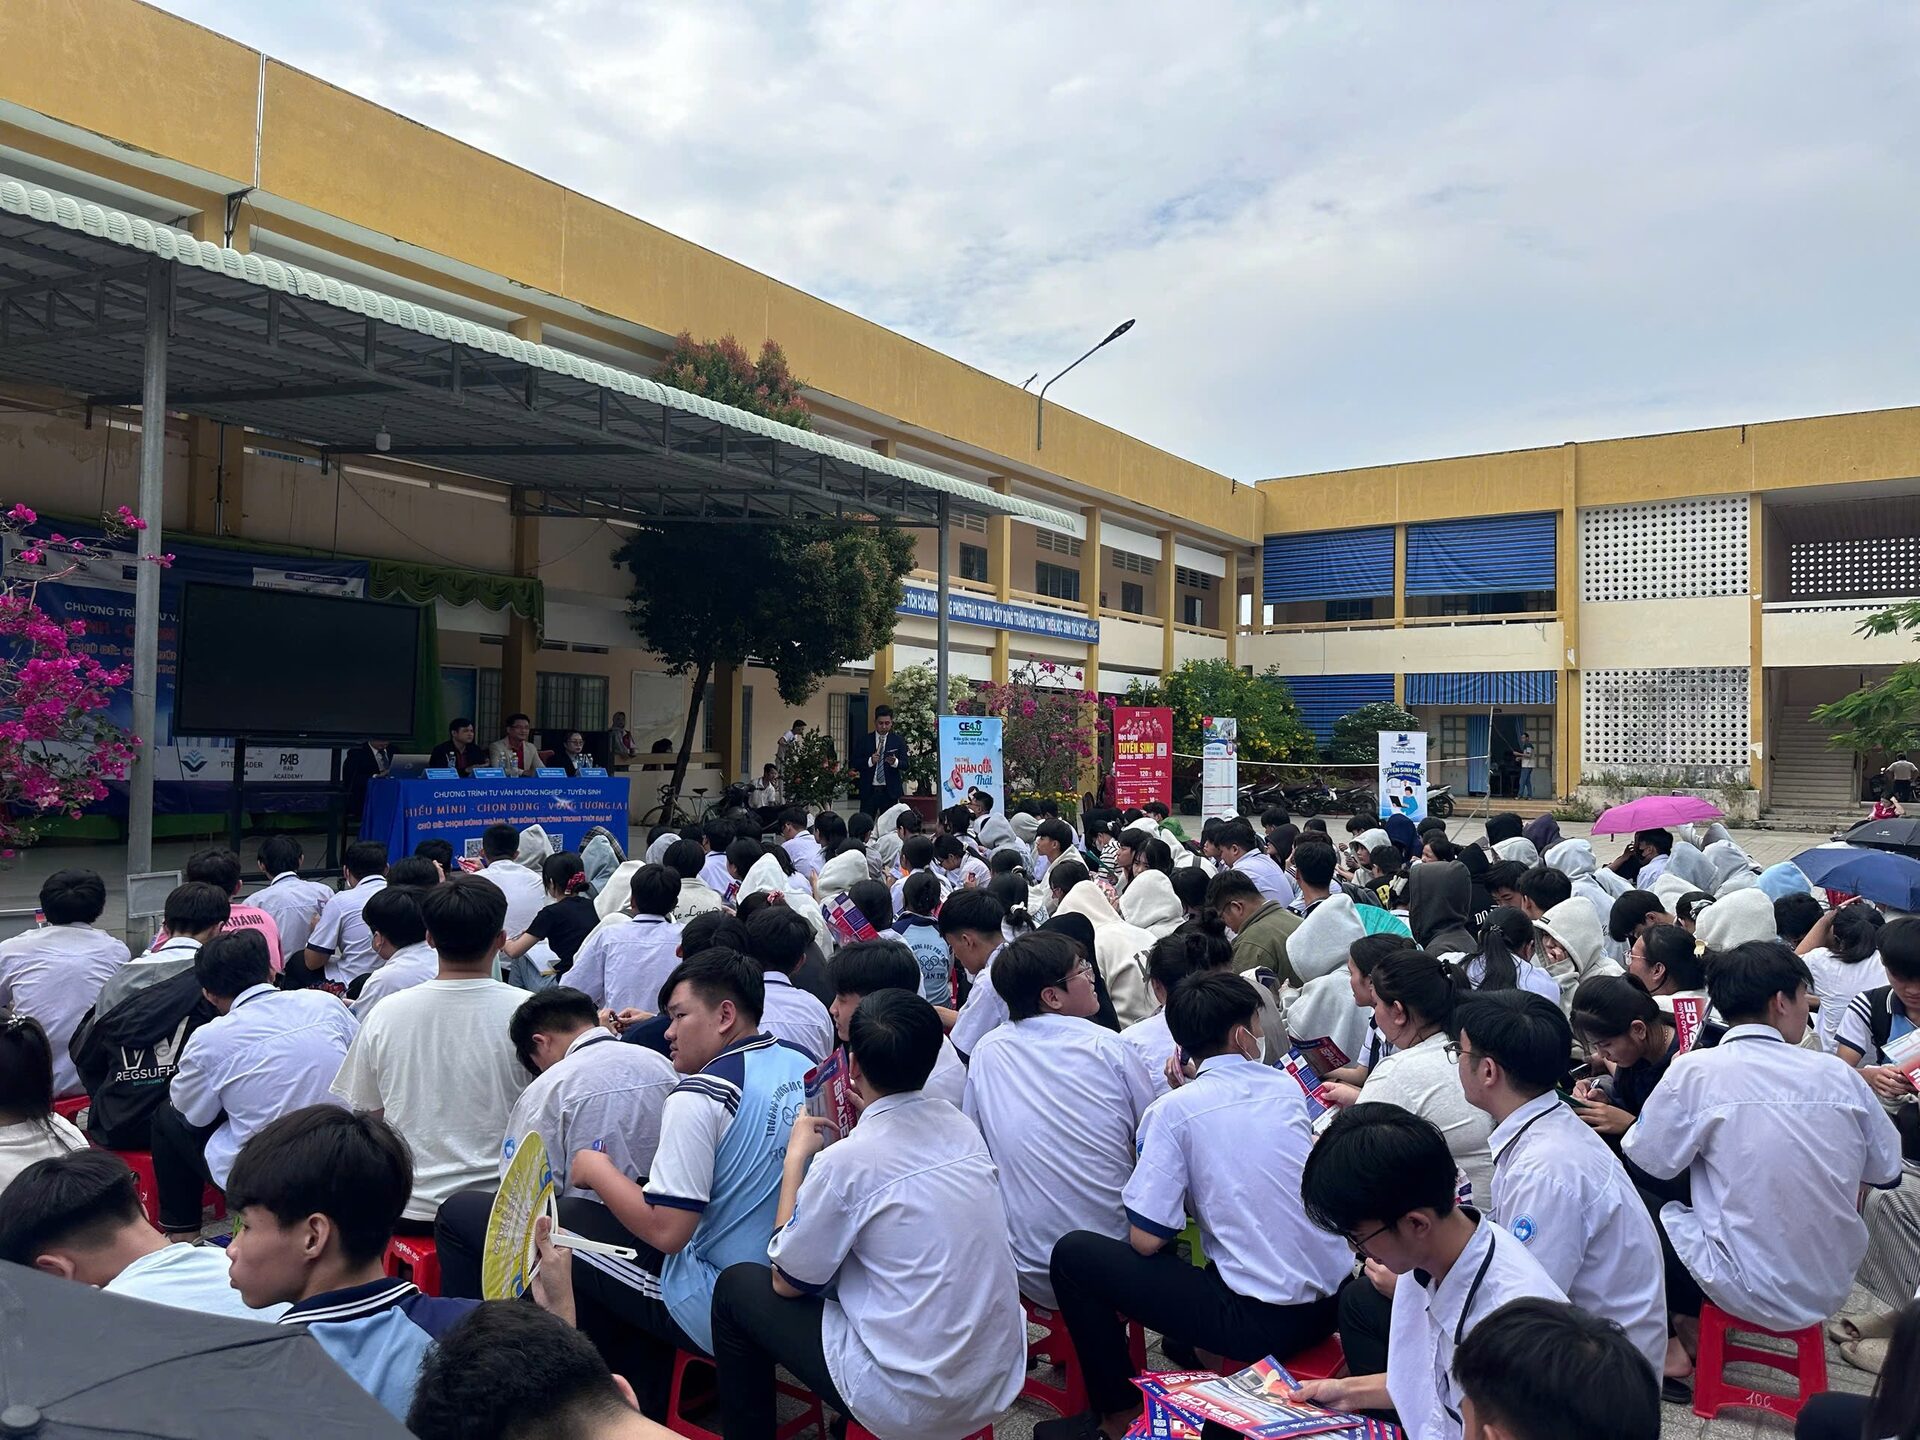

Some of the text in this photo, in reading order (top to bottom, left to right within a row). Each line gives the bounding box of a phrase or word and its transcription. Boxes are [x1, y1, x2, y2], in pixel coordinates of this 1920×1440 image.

[64, 601, 114, 616] CHƯƠNG
[117, 606, 135, 618] TRÌ
[1140, 742, 1154, 753] SINH
[434, 790, 466, 798] CHƯƠNG
[467, 789, 488, 797] TRÌNH
[436, 804, 466, 814] MÌNH
[477, 803, 507, 813] CHỌN
[1684, 1001, 1698, 1047] PACE
